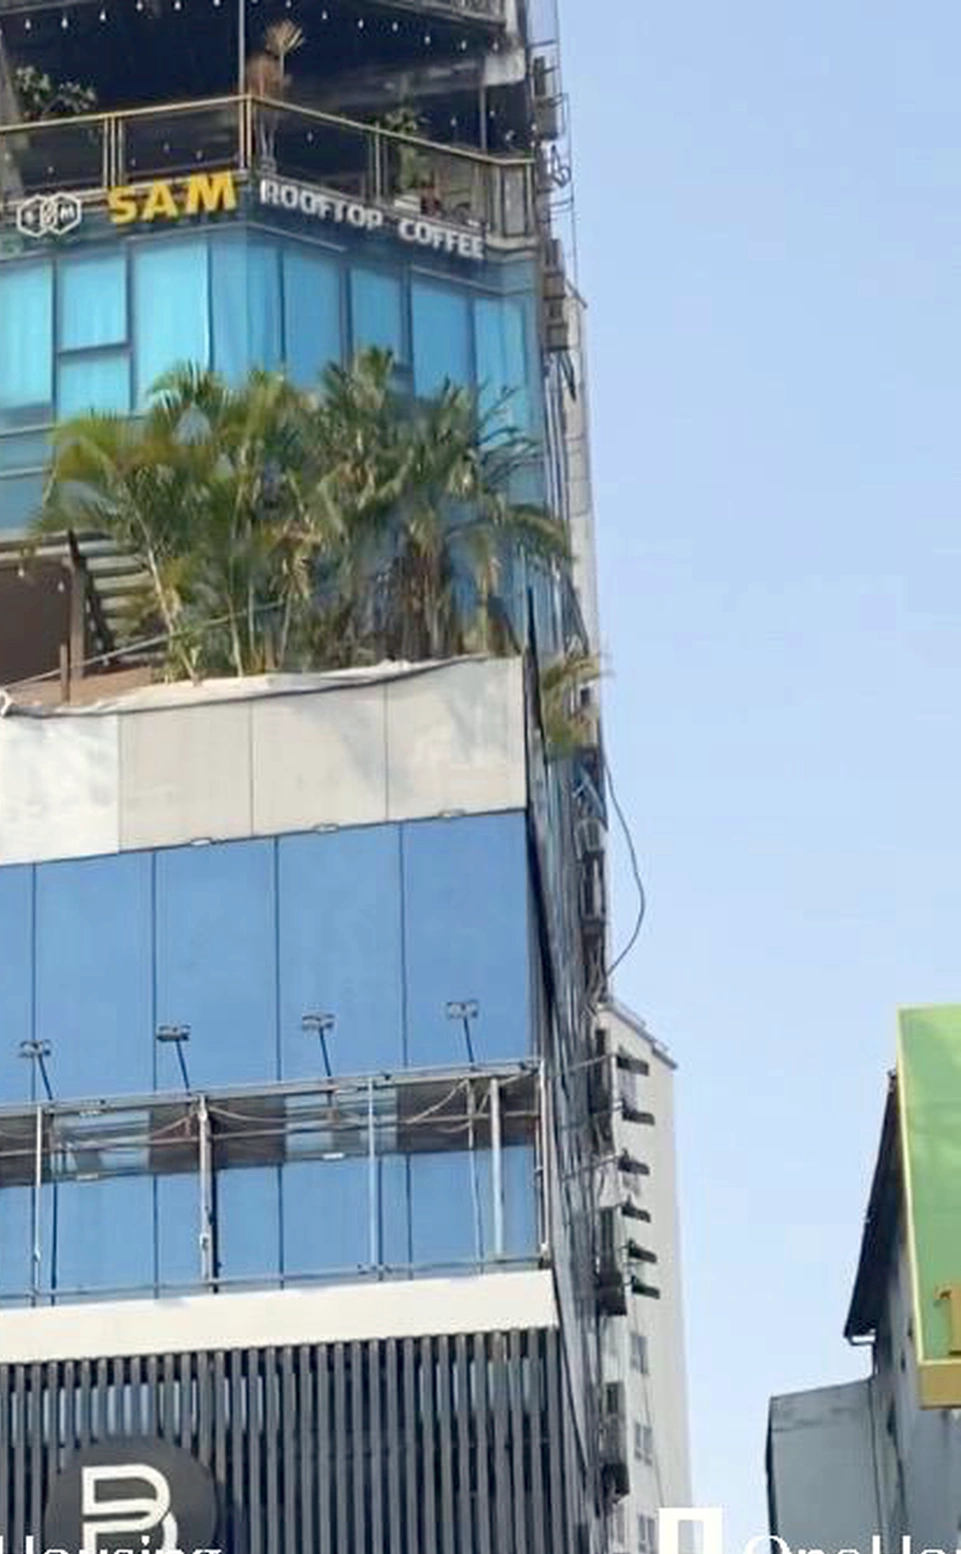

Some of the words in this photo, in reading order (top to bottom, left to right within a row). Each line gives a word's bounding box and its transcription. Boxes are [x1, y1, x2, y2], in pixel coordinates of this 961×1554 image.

[107, 169, 237, 224] SAM
[260, 179, 384, 229] ROOFTOP
[399, 218, 484, 260] COFFEE
